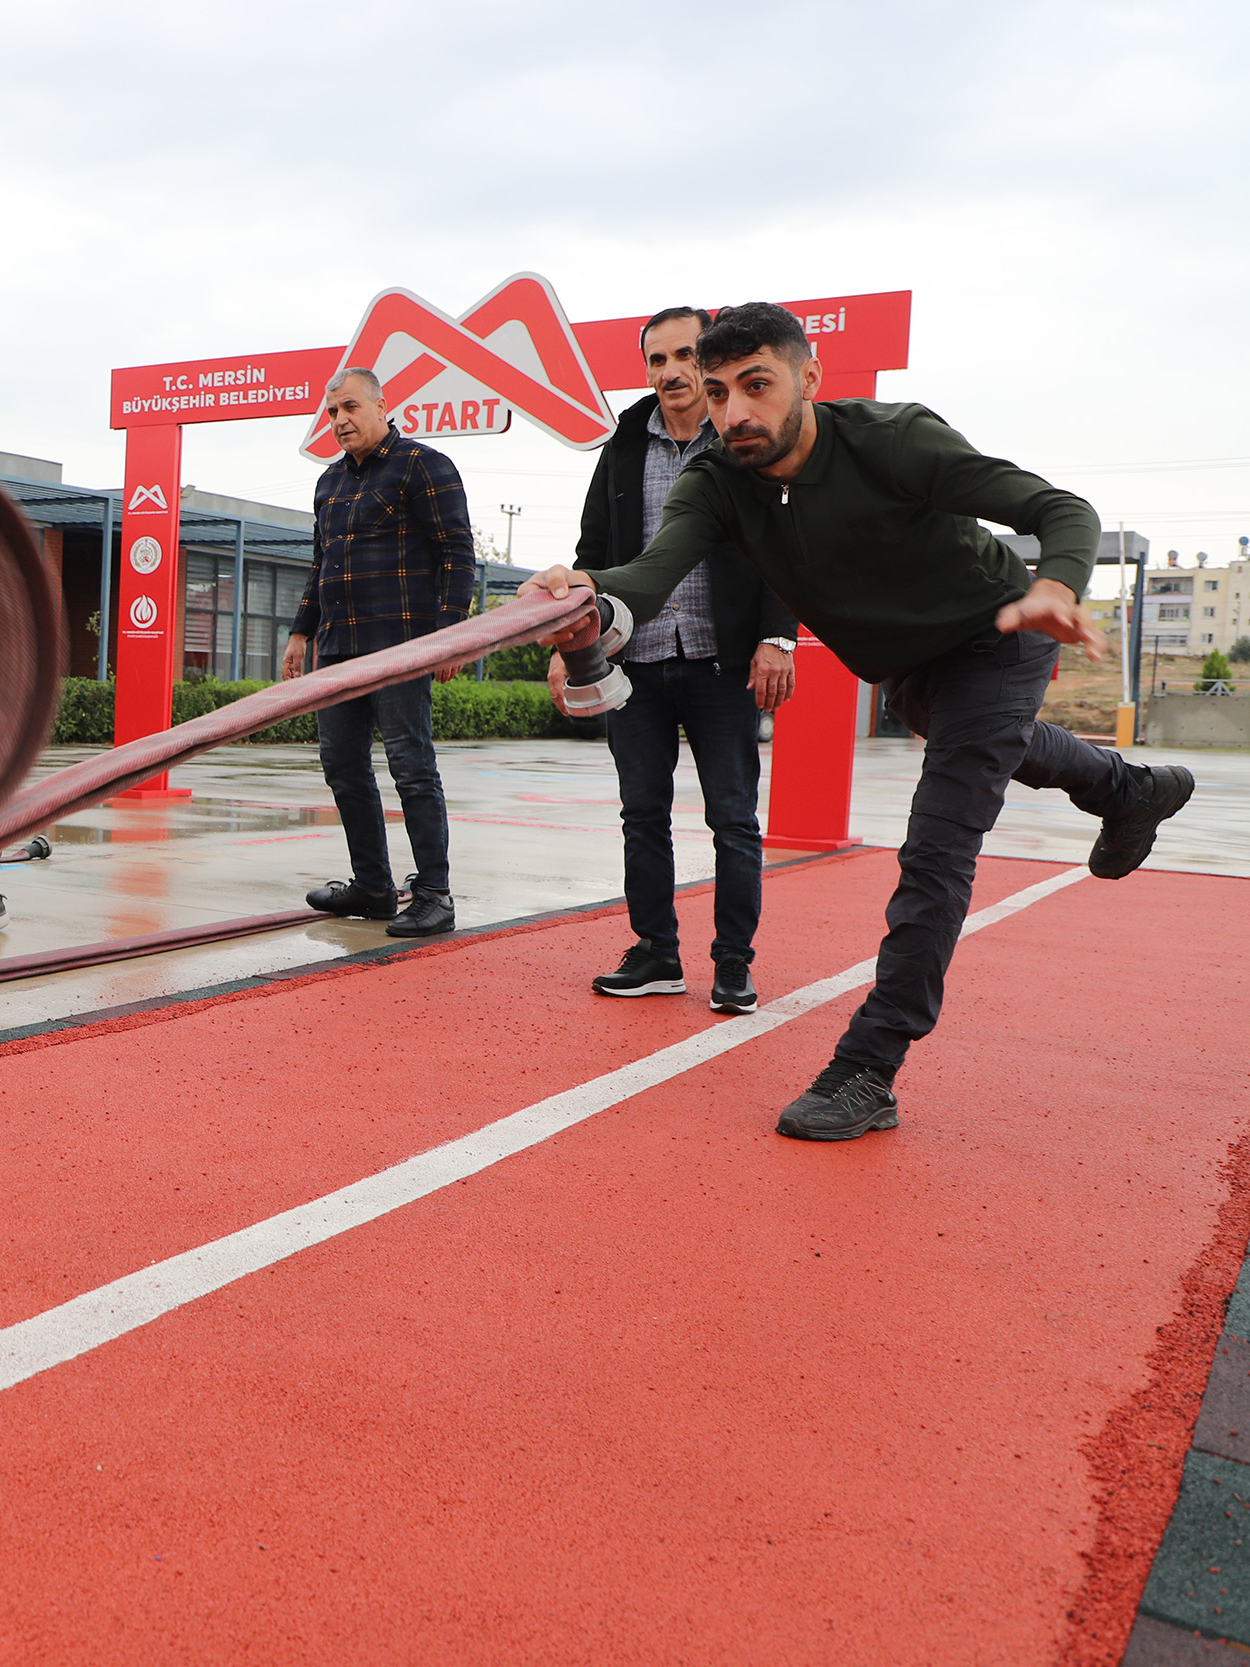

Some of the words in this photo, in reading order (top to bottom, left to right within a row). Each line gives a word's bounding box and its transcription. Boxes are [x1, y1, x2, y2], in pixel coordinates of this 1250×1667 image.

[162, 375, 194, 391] T.C.
[198, 365, 266, 388] MERSİN
[122, 391, 215, 414] BÜYÜKŞEHİR
[219, 382, 310, 406] BELEDİYESİ
[402, 398, 500, 434] START
